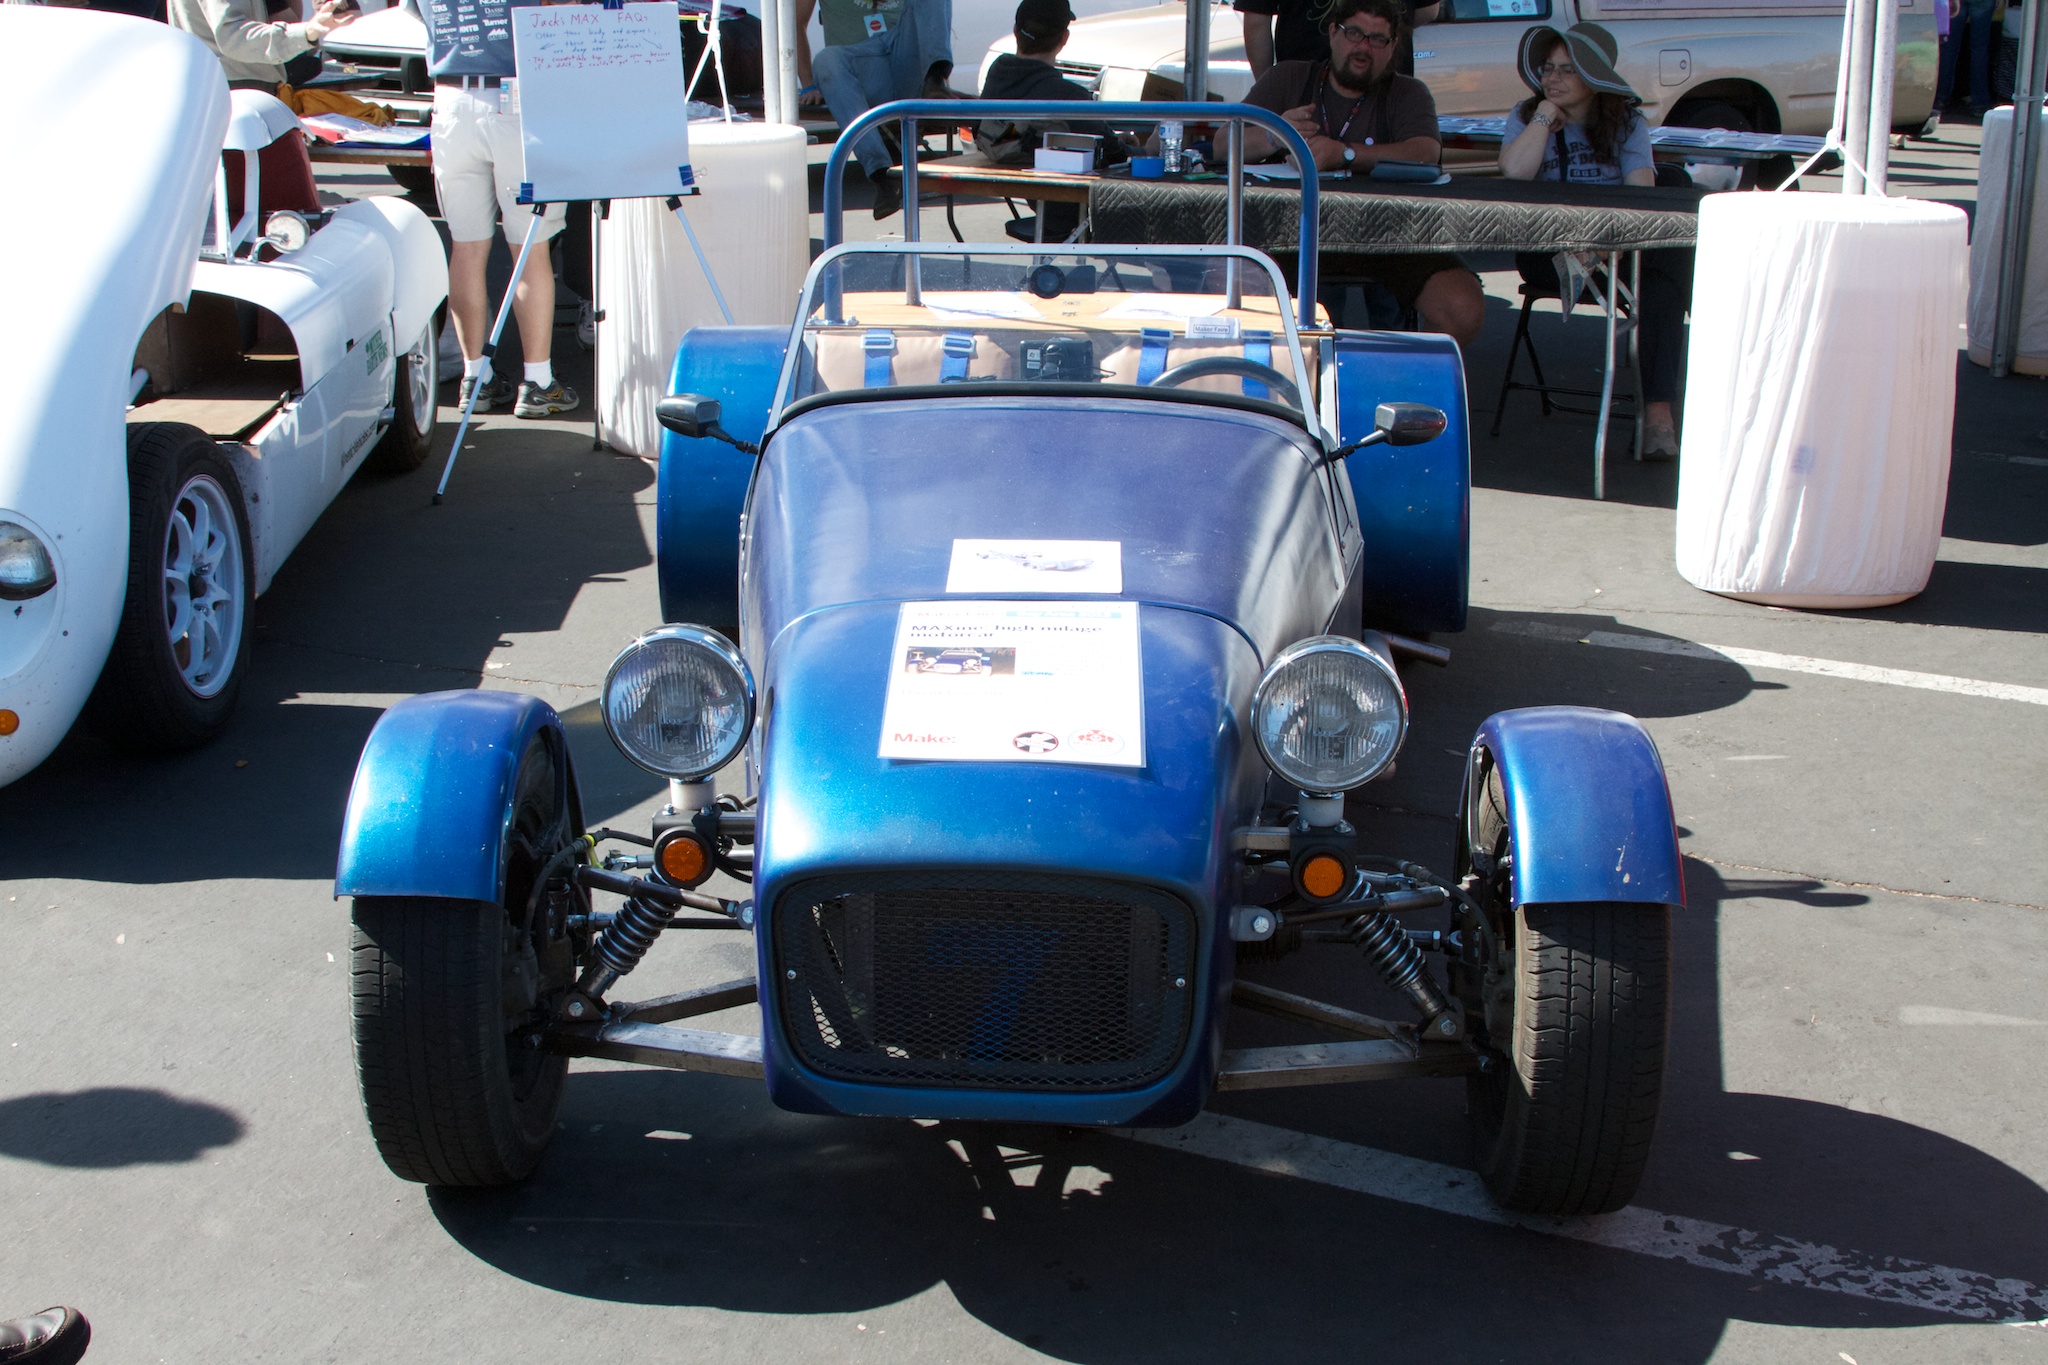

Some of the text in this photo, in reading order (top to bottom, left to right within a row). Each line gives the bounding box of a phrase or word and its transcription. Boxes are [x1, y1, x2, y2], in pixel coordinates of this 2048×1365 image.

[482, 19, 508, 27] Turner
[530, 11, 649, 28] Jack's MAX FAQs
[535, 31, 556, 40] Other
[588, 27, 606, 39] body
[1413, 51, 1436, 59] COMA
[533, 56, 545, 64] The
[995, 624, 1034, 632] high
[1040, 625, 1102, 633] milage
[894, 733, 957, 744] Make:
